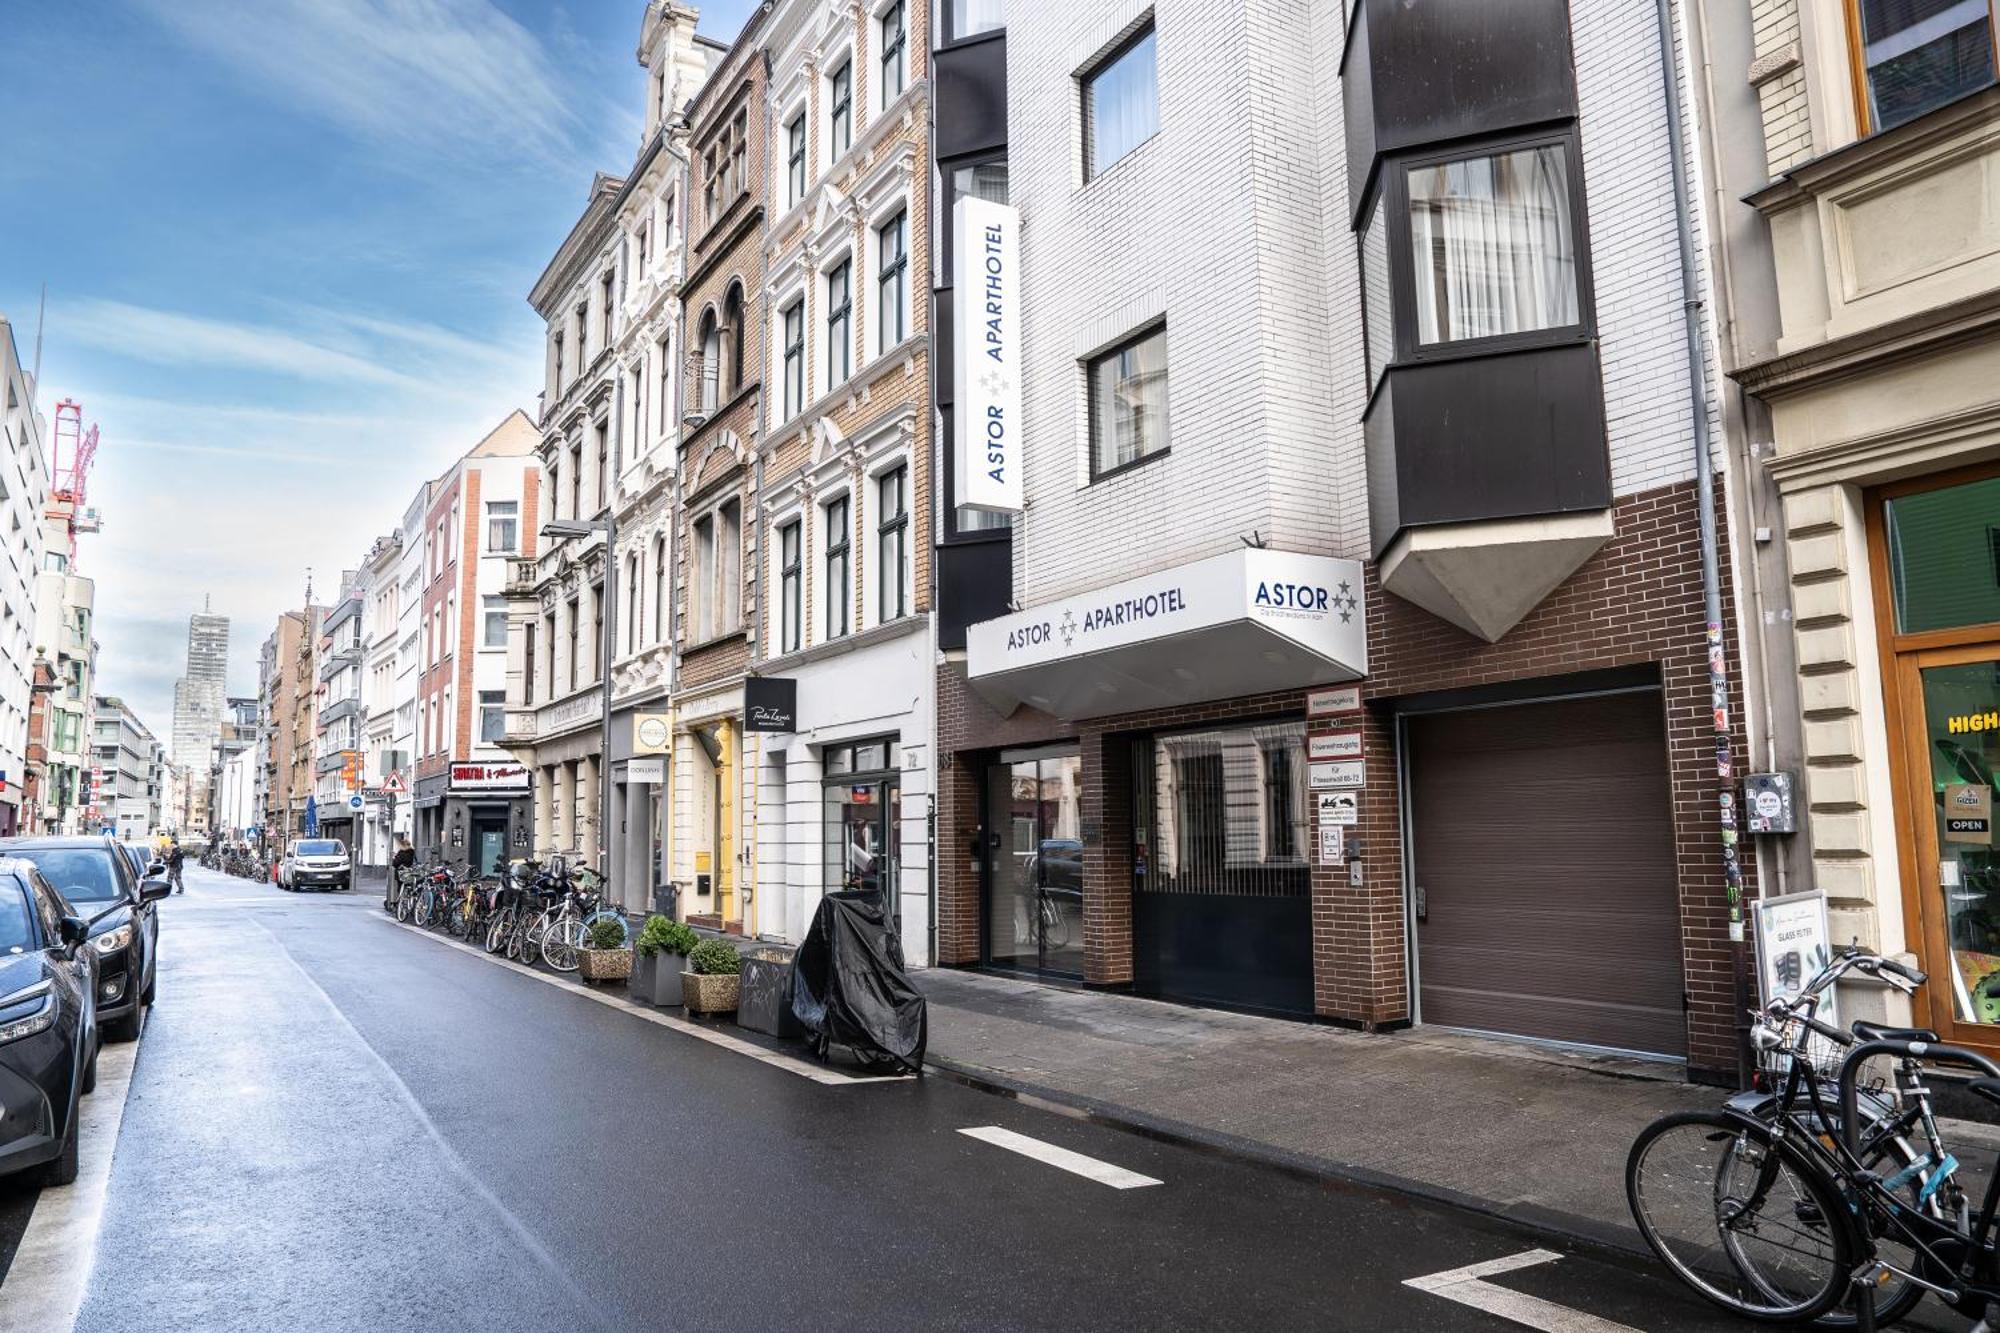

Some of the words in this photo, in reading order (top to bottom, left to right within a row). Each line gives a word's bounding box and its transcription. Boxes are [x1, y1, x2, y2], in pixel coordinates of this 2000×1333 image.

[986, 223, 1003, 363] APARTHOTEL
[987, 405, 1004, 484] ASTOR
[1007, 622, 1050, 650] ASTOR
[1083, 587, 1186, 633] APARTHOTEL
[1255, 581, 1328, 610] ASTOR
[1952, 820, 1982, 830] OPEN
